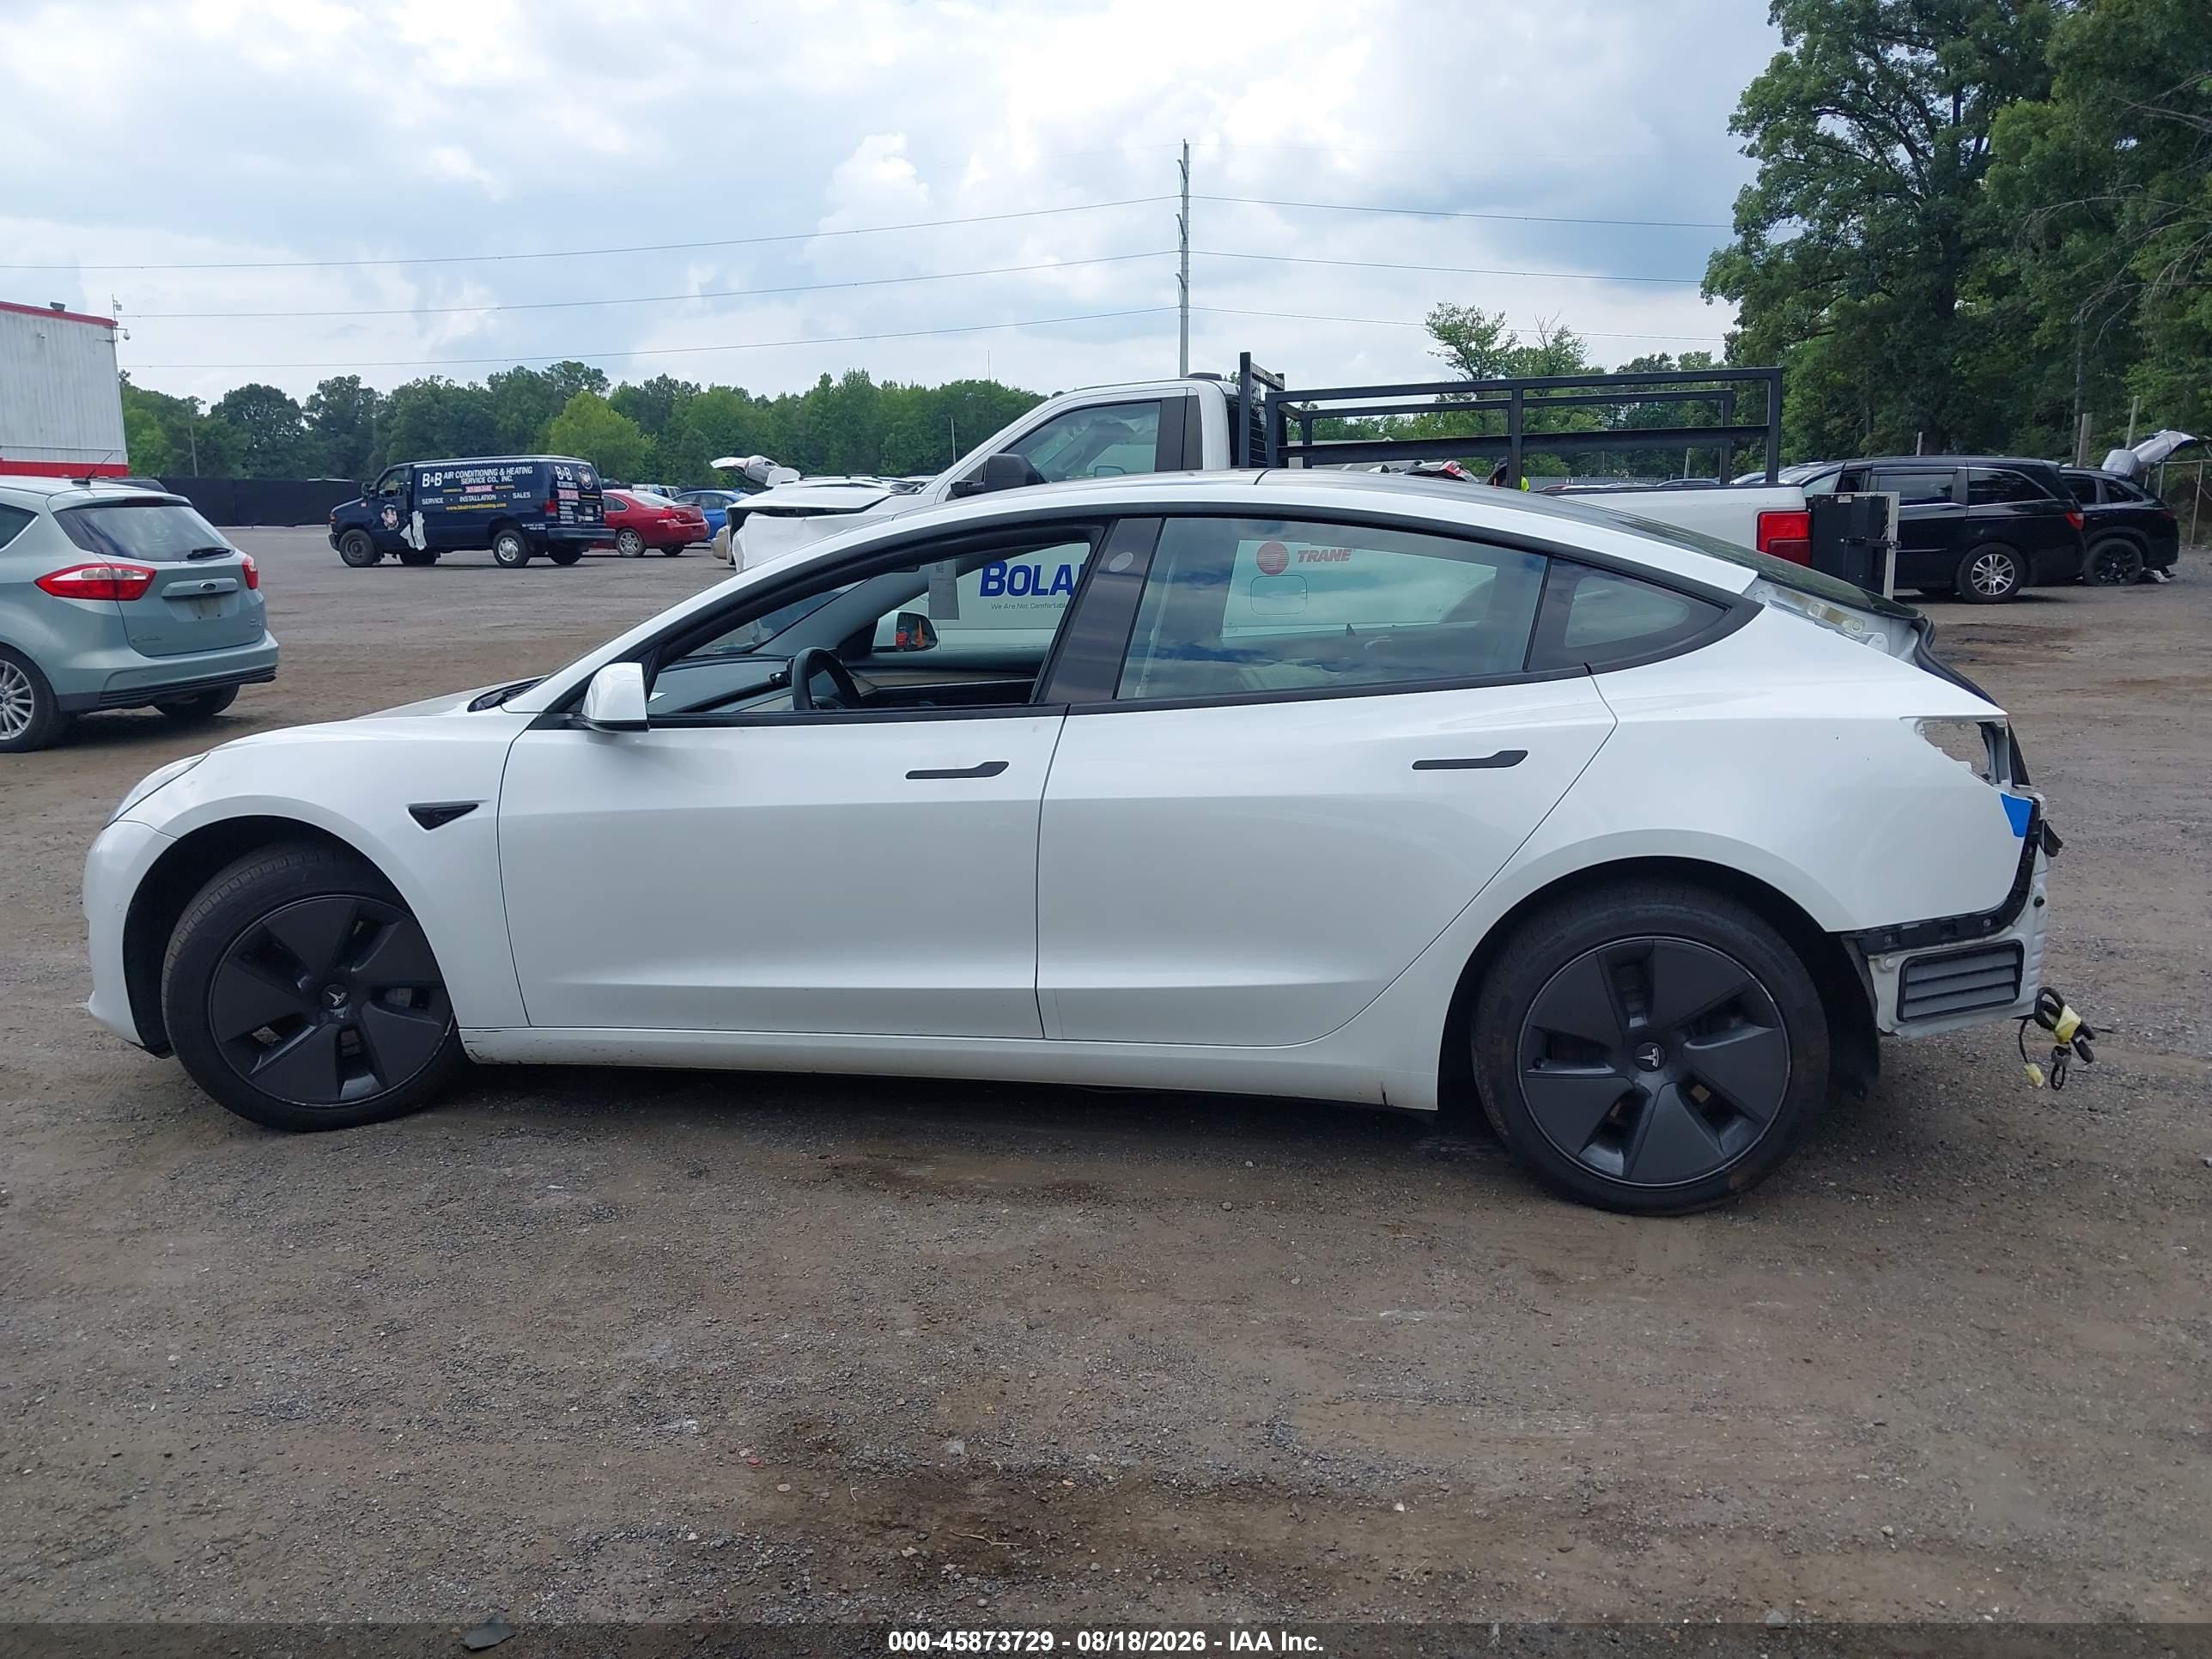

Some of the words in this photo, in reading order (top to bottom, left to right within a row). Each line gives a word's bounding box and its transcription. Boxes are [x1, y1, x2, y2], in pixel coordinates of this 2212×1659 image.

[422, 472, 443, 488] B&B
[443, 471, 455, 480] AIR
[455, 468, 498, 479] CONDITIONING
[499, 467, 505, 476] &
[506, 466, 533, 476] HEATING
[555, 465, 573, 481] B&B
[460, 477, 487, 485] SERVICE
[422, 497, 444, 506] SERVICE
[459, 494, 497, 502] INSTALLATION
[512, 491, 531, 500] SALES
[1297, 549, 1353, 563] TRANE
[1030, 601, 1066, 610] Comfortabl
